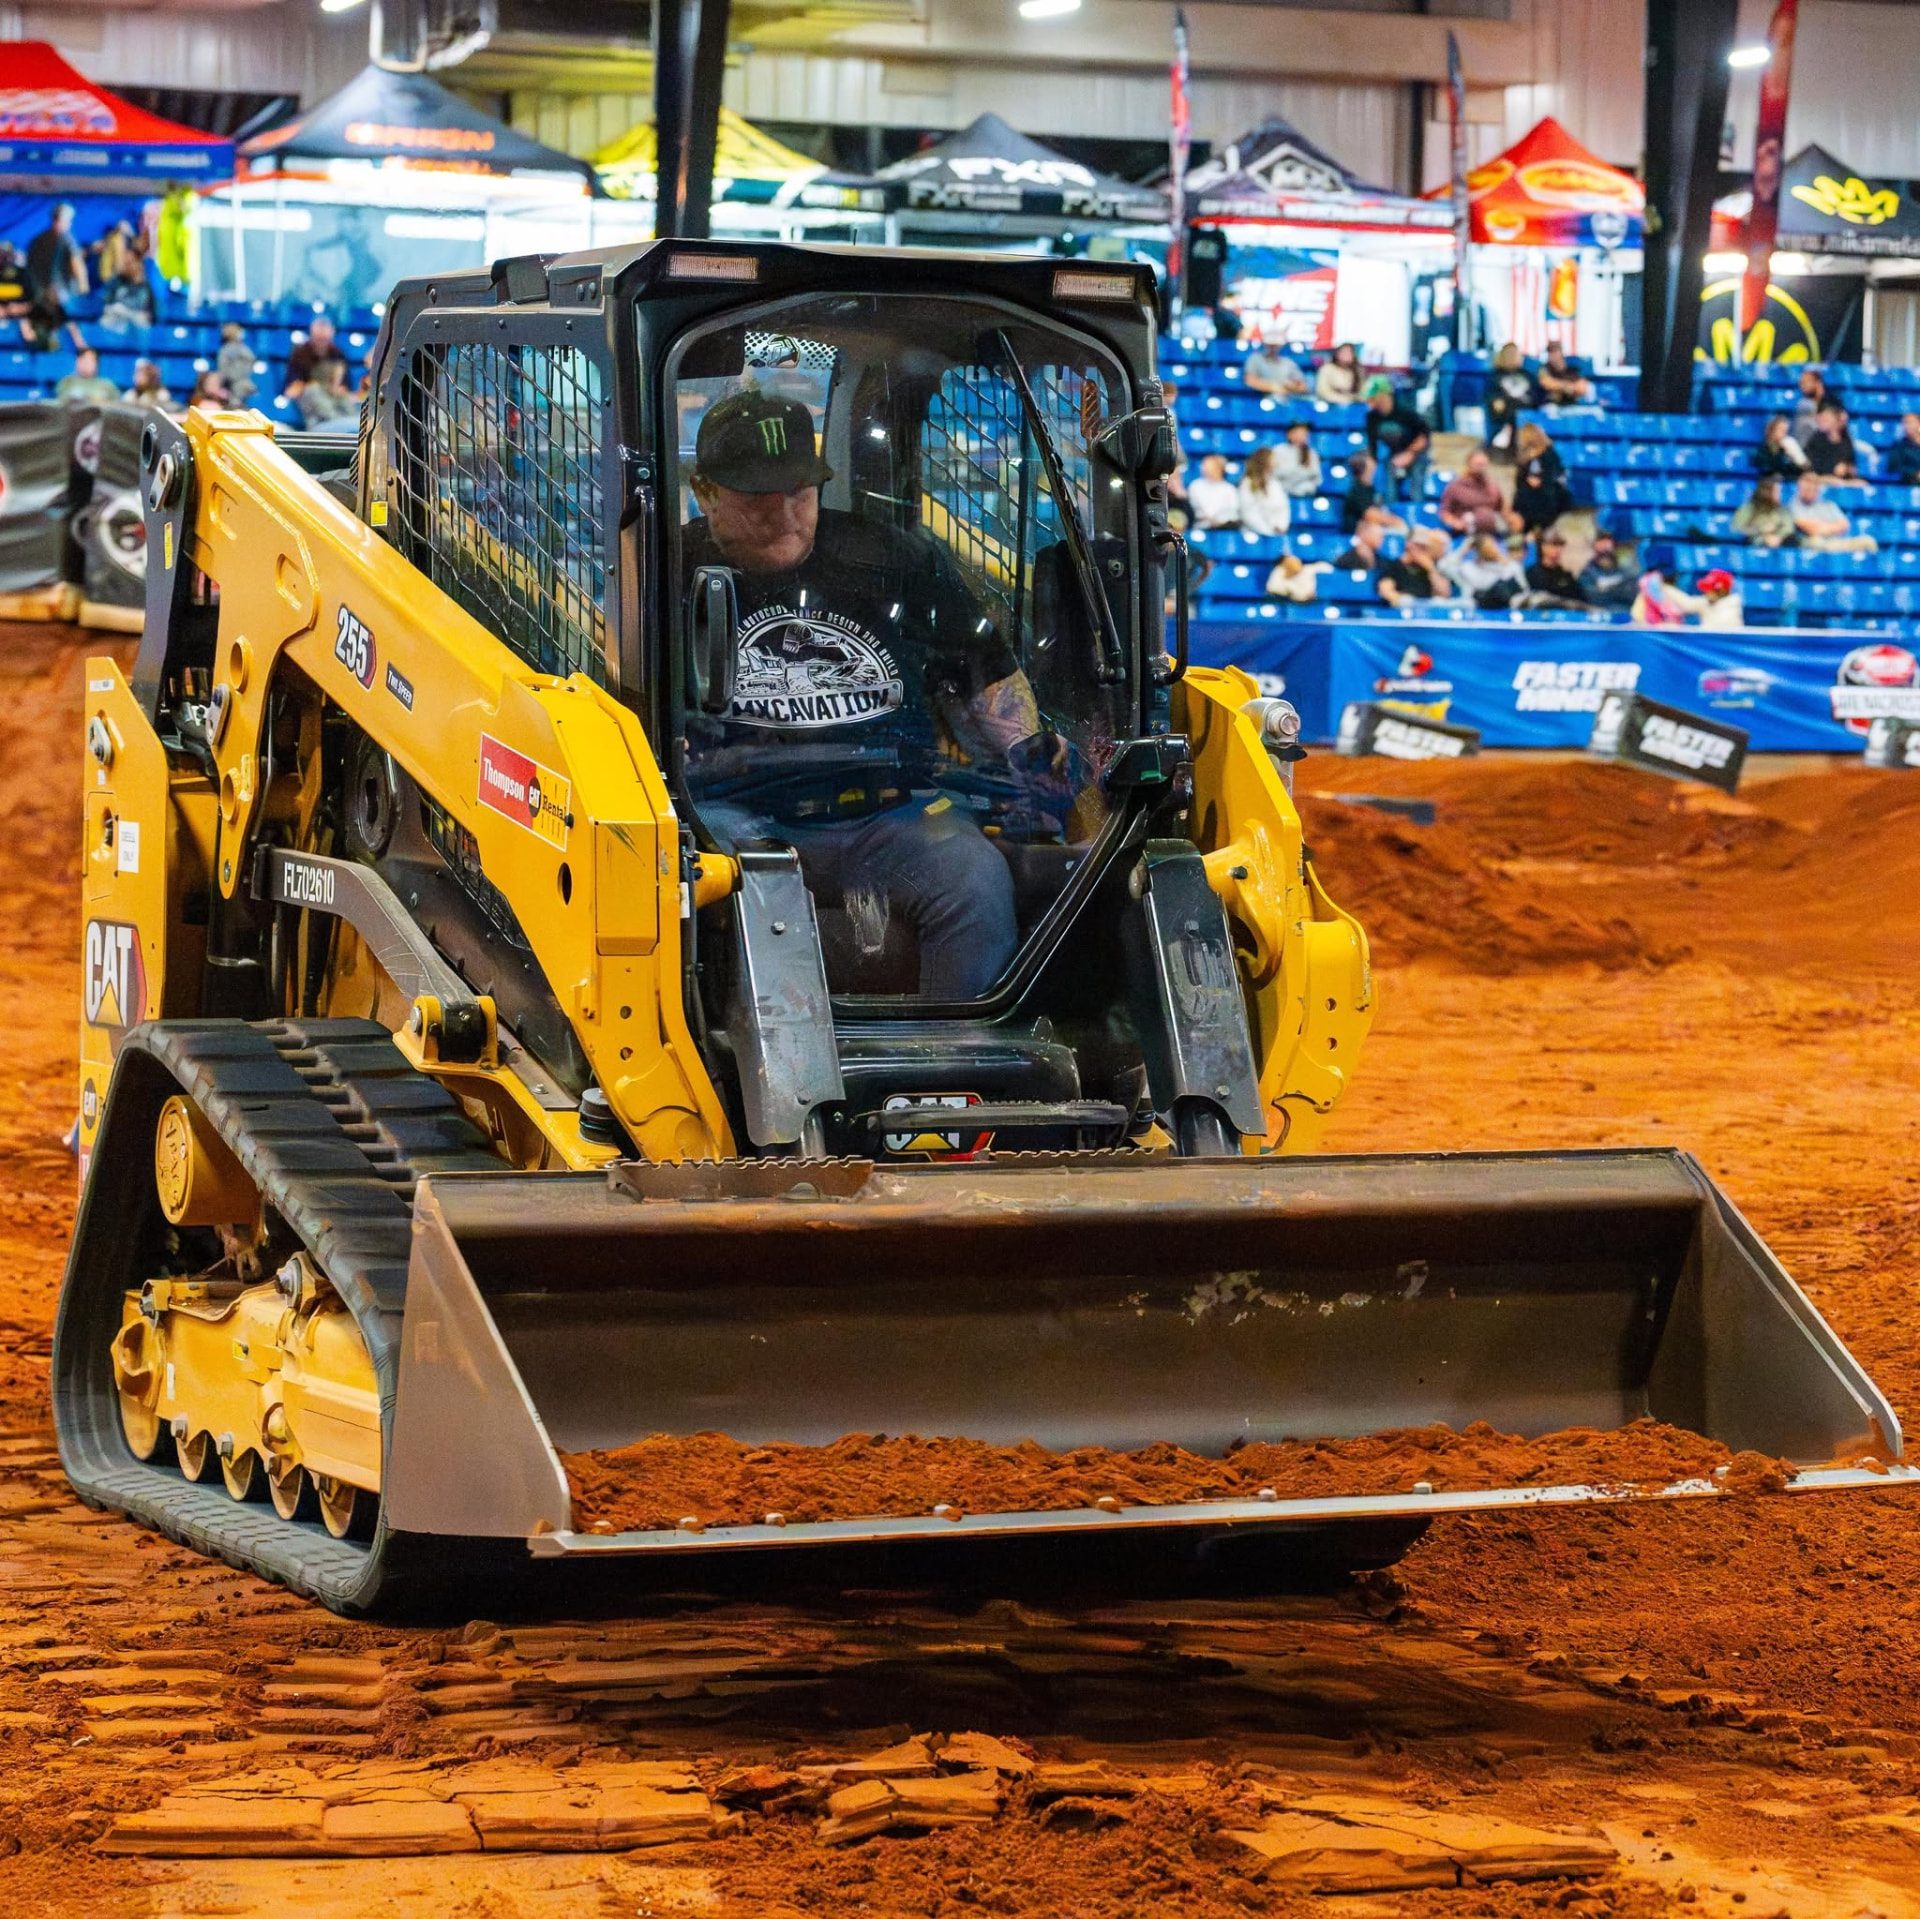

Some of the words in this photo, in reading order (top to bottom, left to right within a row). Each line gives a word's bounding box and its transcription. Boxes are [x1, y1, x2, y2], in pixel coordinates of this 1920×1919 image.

[335, 607, 369, 678] 255
[827, 612, 861, 634] DESIGN
[862, 630, 881, 649] AND
[1512, 661, 1642, 690] FASTER
[1641, 714, 1735, 761] FASTER
[483, 757, 525, 802] Thompson
[284, 861, 335, 905] FL702610
[86, 921, 132, 1028] CAT
